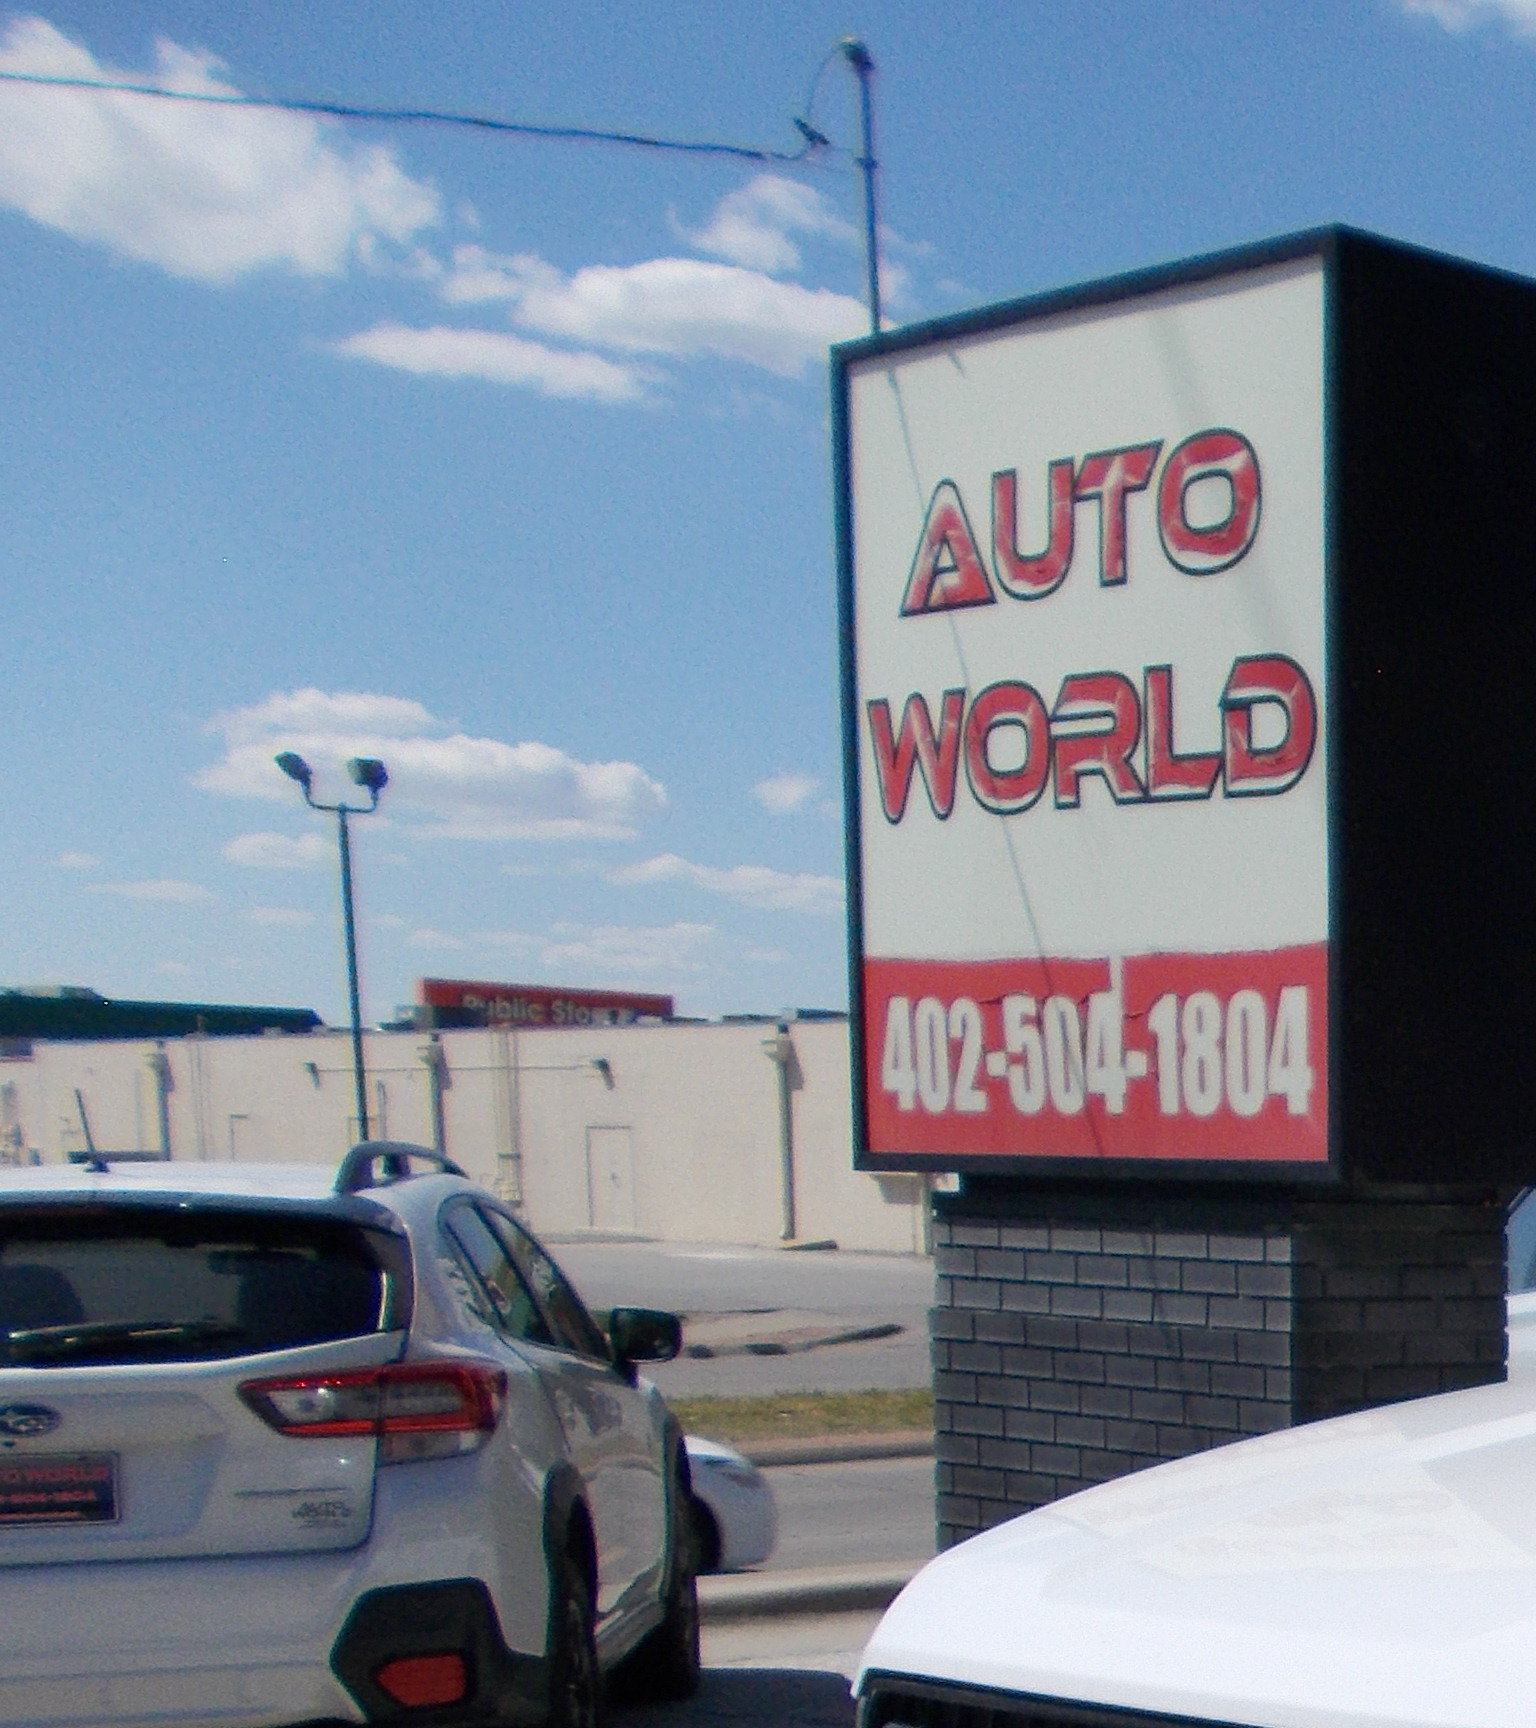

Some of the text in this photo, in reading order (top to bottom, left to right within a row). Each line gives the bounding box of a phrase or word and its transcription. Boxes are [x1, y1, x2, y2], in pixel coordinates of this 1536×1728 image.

[899, 427, 1262, 617] AUTO
[867, 653, 1318, 824] WORLD
[882, 984, 1313, 1117] 402-504-1804
